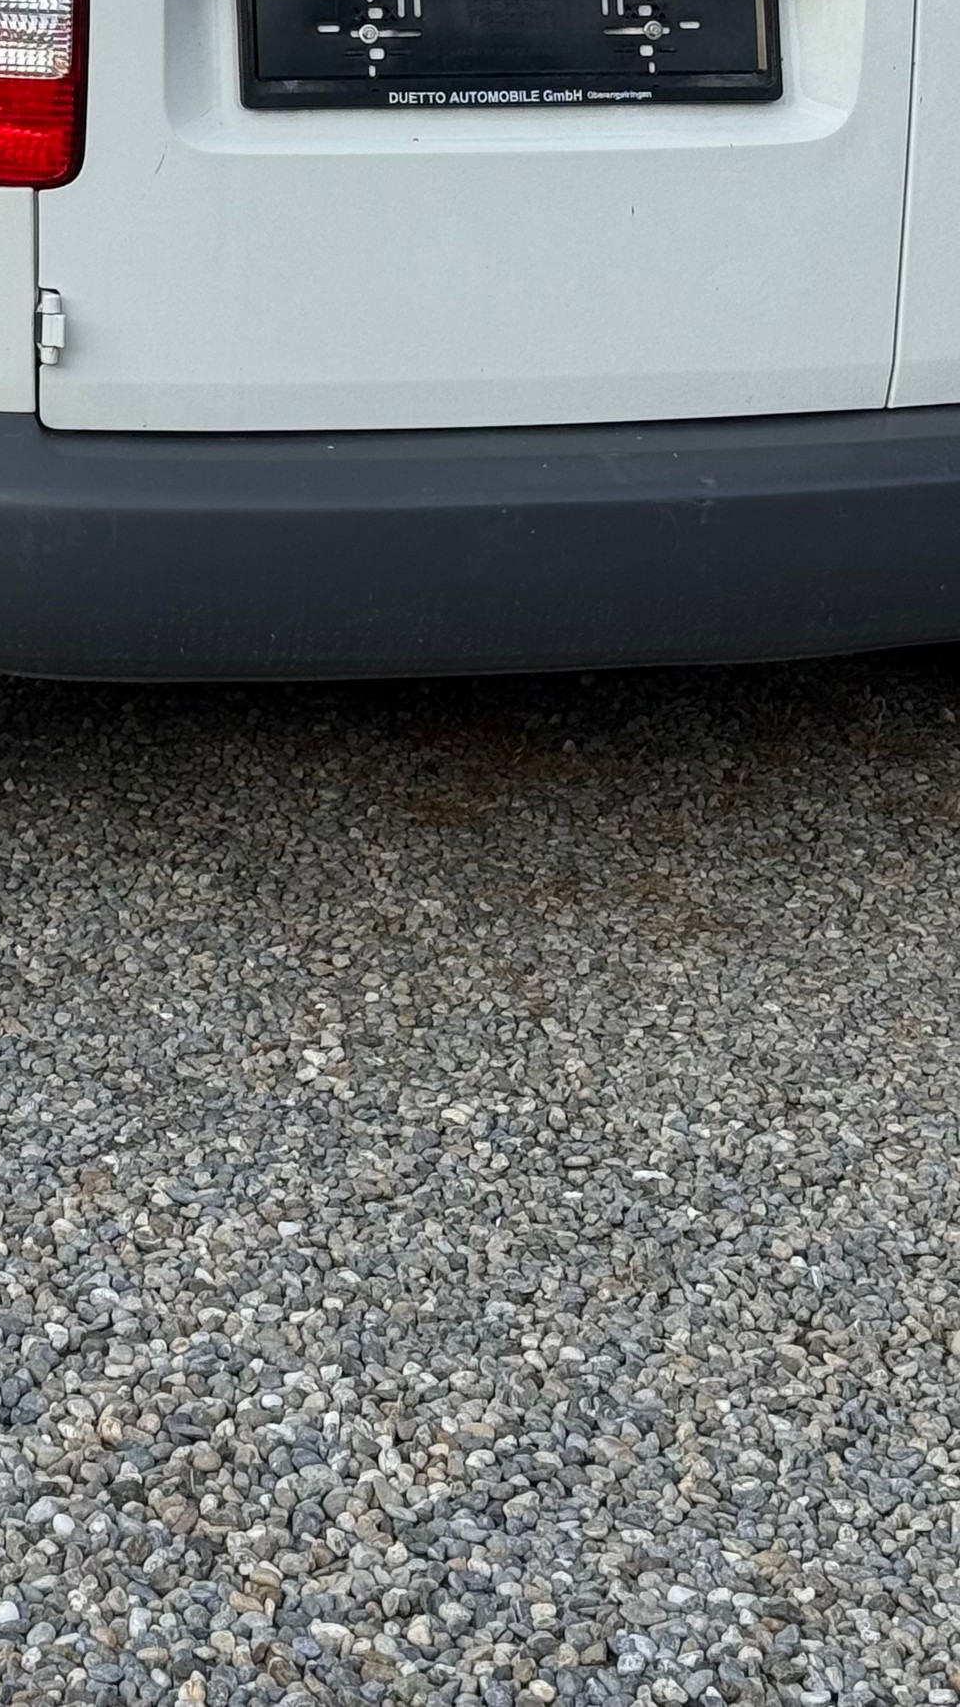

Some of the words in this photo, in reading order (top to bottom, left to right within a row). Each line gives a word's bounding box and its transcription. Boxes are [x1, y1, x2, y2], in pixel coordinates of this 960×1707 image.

[388, 91, 446, 104] DUETTO
[449, 90, 540, 104] AUTOMOBILE
[542, 89, 583, 102] GmbH
